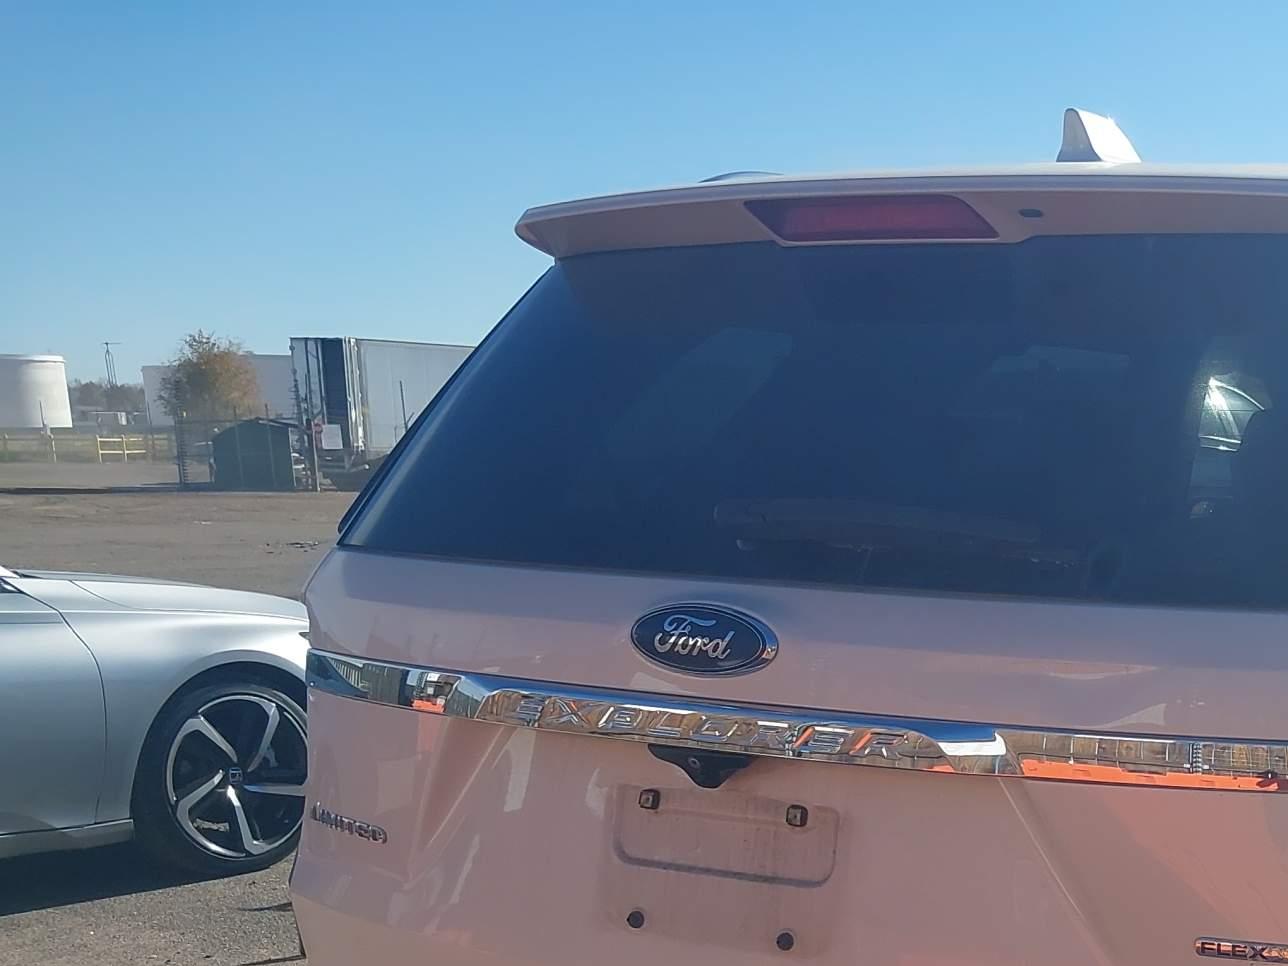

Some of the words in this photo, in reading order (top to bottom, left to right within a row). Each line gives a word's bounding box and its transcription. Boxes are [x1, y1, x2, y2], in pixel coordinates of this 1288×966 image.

[654, 614, 735, 659] Ford
[516, 694, 909, 760] EXPLORER
[311, 802, 388, 844] LIMITED
[1200, 941, 1269, 959] FLEX
